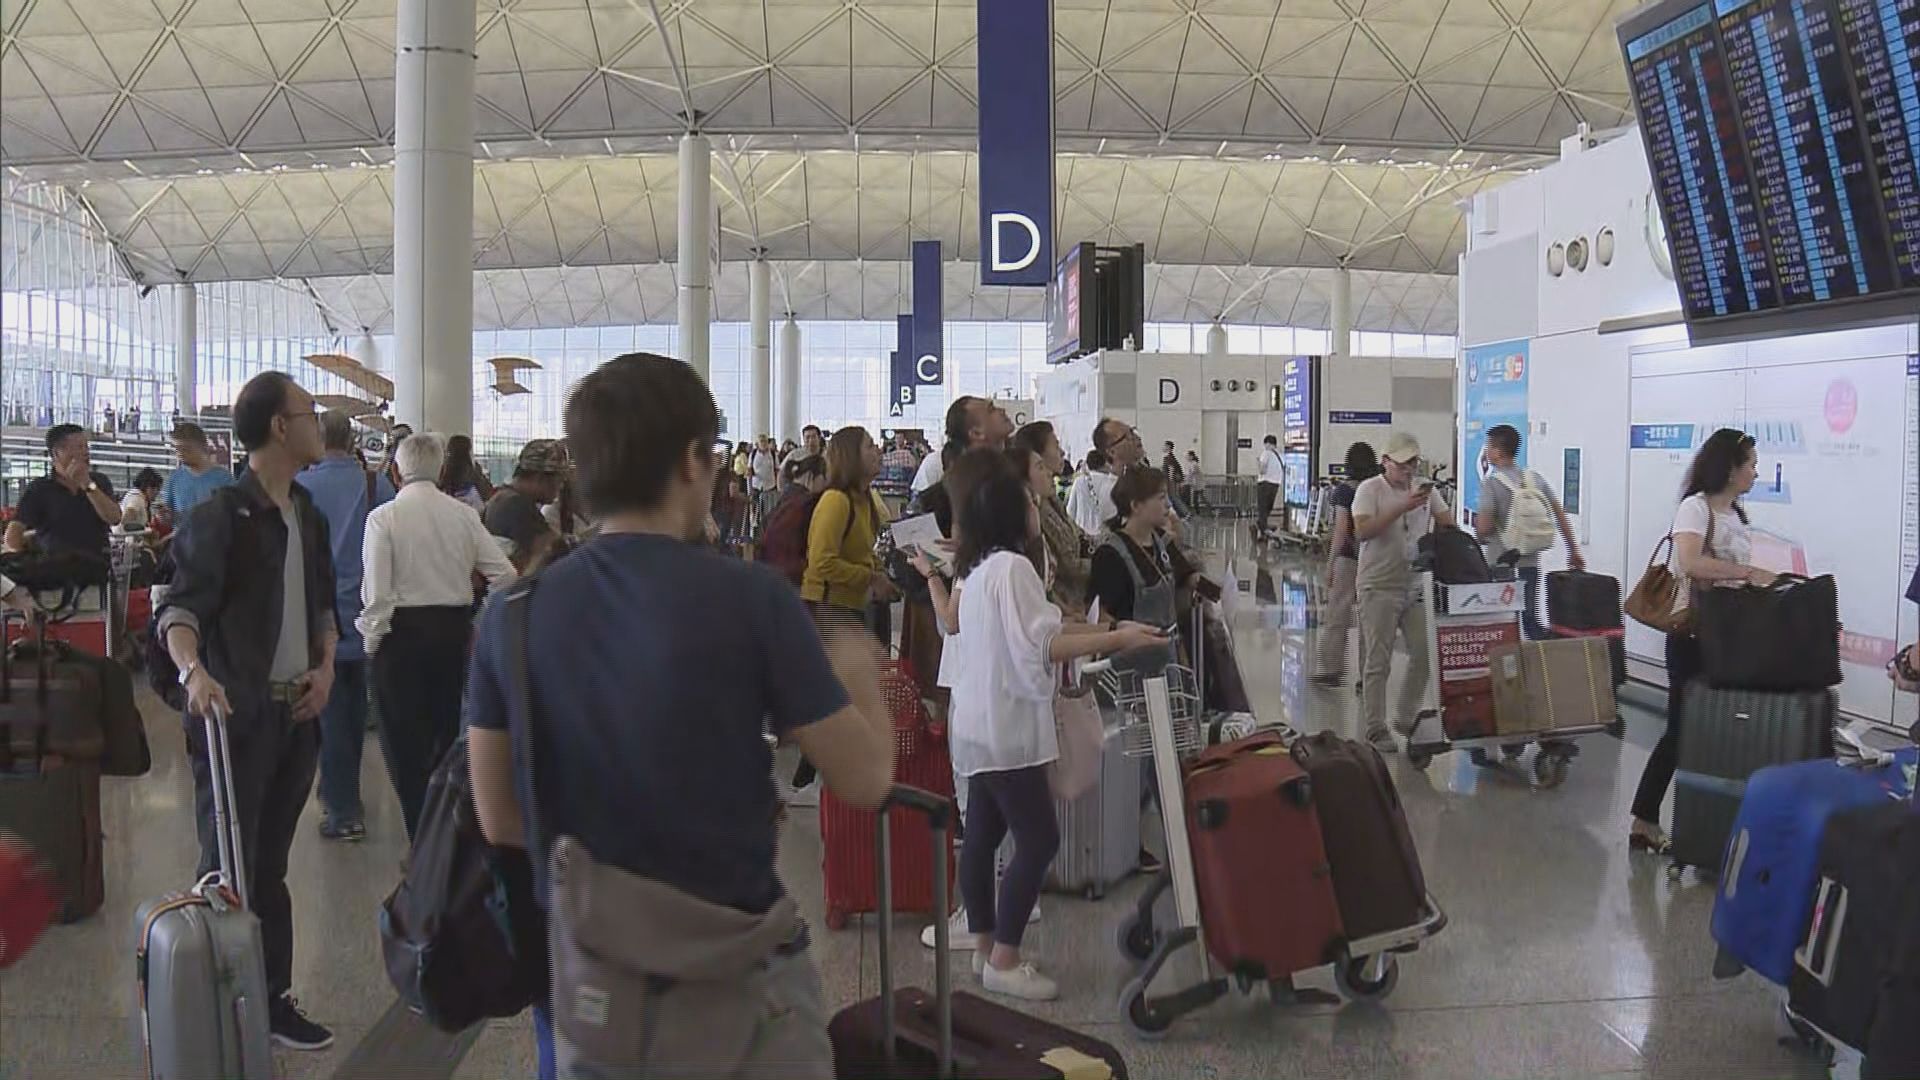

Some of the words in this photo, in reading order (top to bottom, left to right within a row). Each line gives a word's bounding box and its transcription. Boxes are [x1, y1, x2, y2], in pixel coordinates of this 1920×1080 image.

[991, 213, 1041, 272] D
[916, 355, 939, 382] C
[900, 386, 912, 403] B
[1159, 378, 1180, 404] D
[890, 402, 903, 416] A
[1015, 412, 1026, 426] C
[1441, 631, 1503, 643] INTELLIGENT
[1441, 643, 1485, 655] QUALITY
[1442, 654, 1489, 666] ASSURAN
